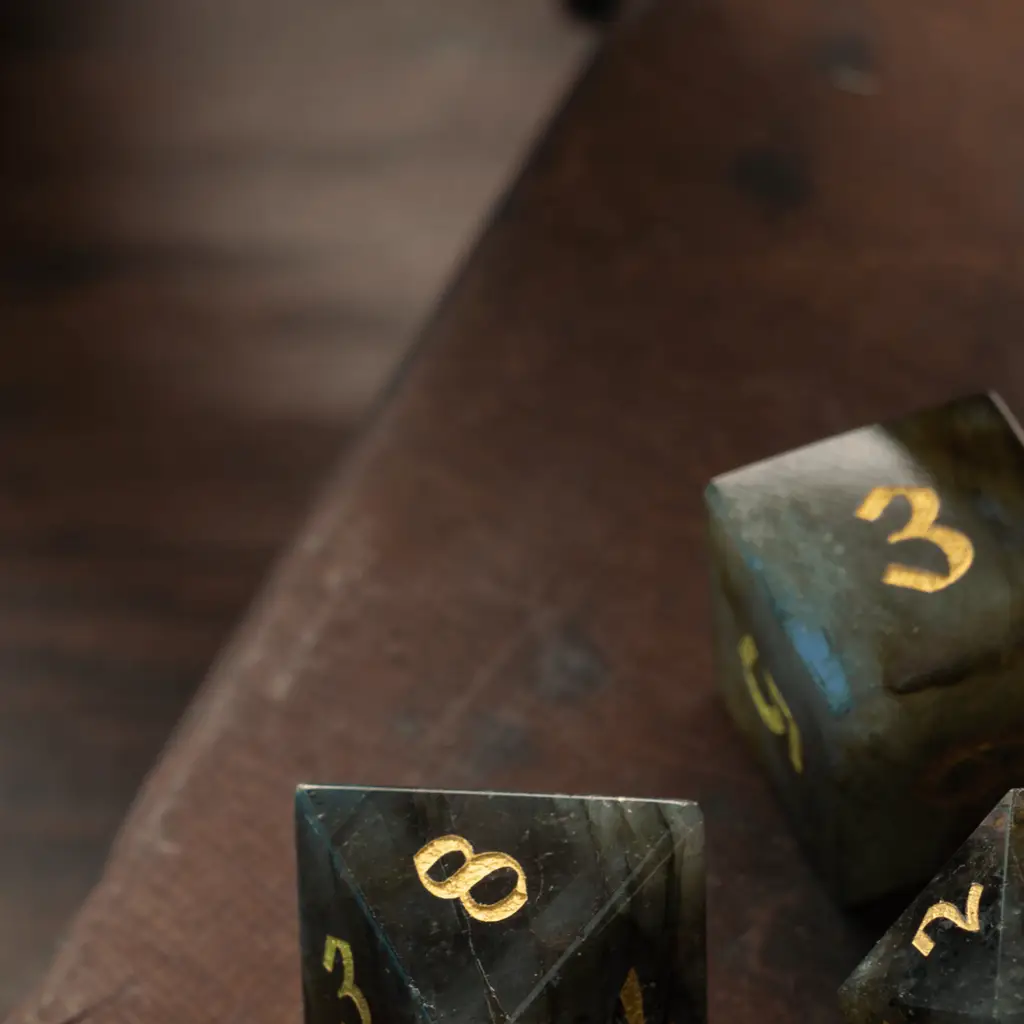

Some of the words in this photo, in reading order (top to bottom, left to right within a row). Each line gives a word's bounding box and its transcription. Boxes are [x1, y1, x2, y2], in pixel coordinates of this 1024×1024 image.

[855, 486, 974, 592] 3
[413, 834, 528, 922] 8
[912, 882, 984, 957] 2
